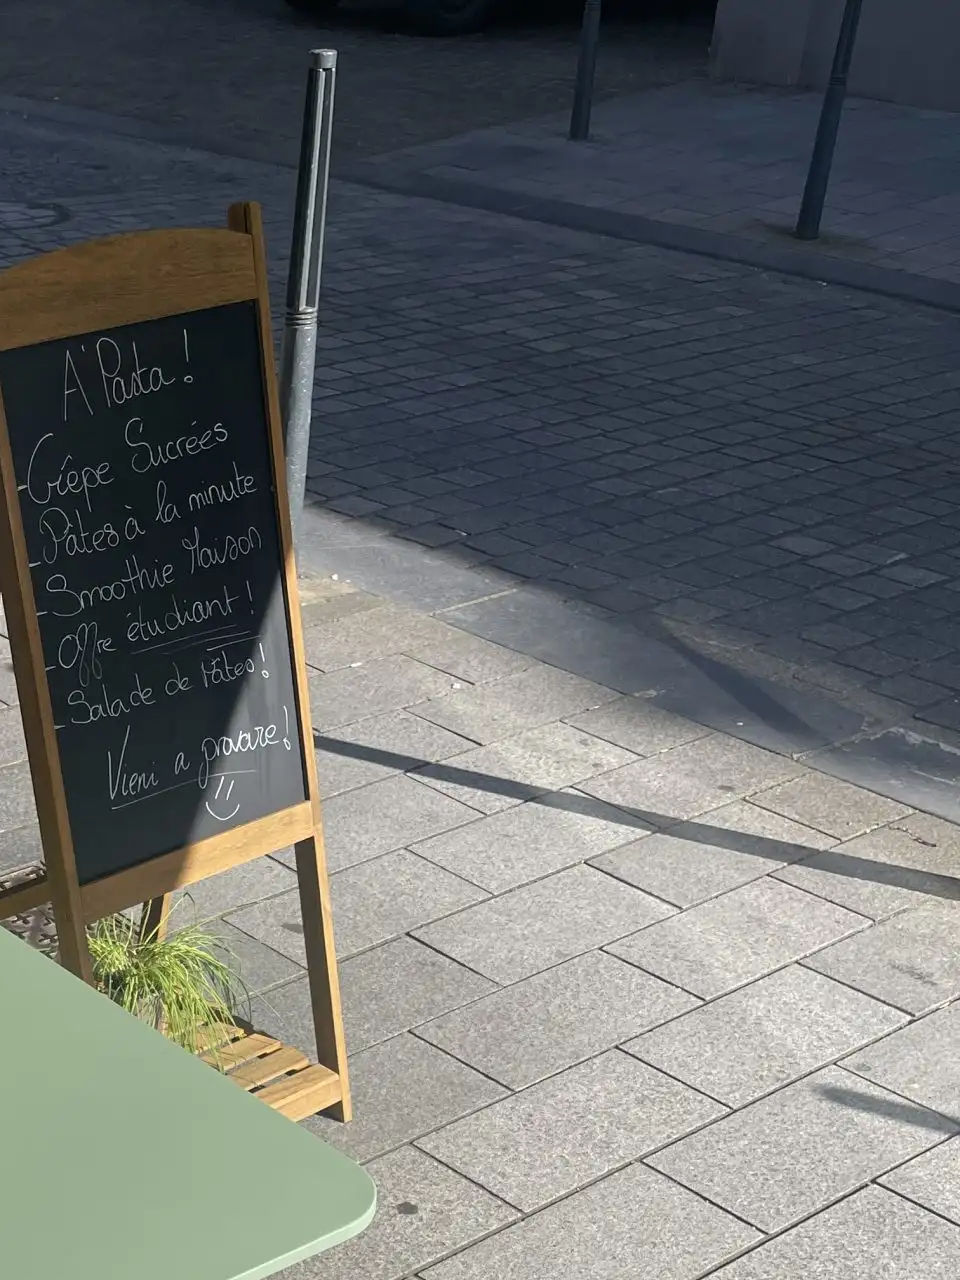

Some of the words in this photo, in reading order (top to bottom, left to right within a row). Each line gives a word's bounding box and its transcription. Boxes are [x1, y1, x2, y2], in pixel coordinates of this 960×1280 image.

[125, 417, 228, 472] Sucrées
[124, 504, 146, 540] à
[156, 480, 181, 523] la
[189, 460, 257, 512] minute
[45, 554, 175, 617] Smoothie
[58, 621, 117, 687] Offre
[67, 672, 156, 724] Salade
[165, 661, 193, 696] de
[107, 724, 159, 800] Vieni
[174, 751, 190, 775] a
